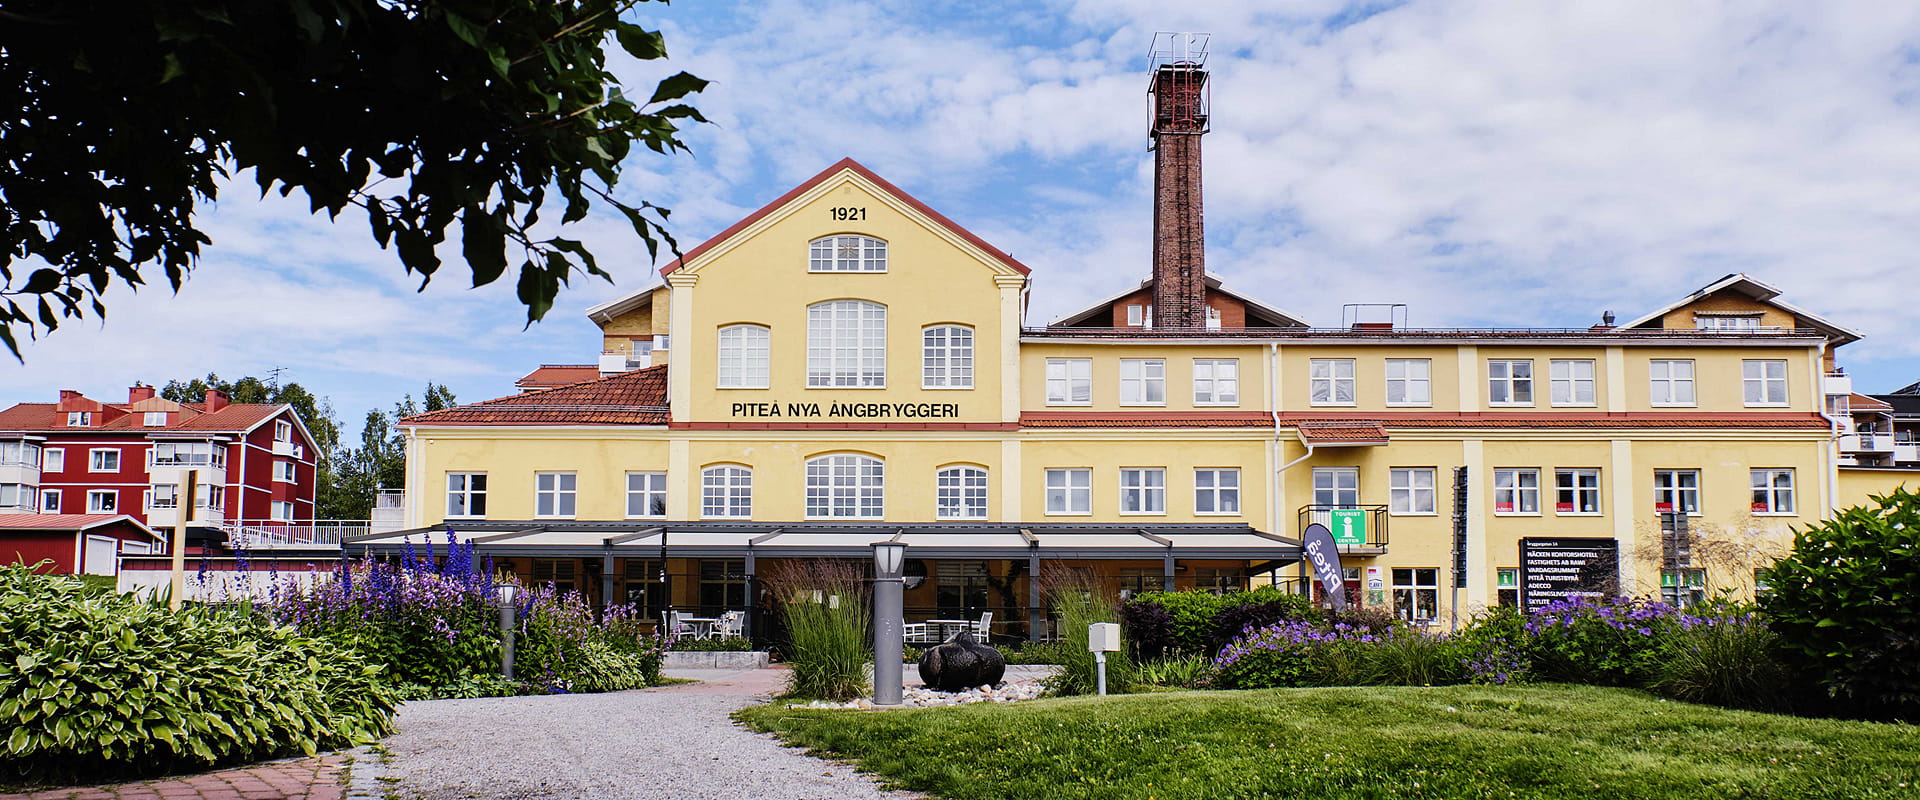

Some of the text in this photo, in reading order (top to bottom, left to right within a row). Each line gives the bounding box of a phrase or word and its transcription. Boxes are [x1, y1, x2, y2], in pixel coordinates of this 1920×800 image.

[830, 207, 866, 221] 1921
[732, 399, 959, 418] PITEÅ NYA ÅNGBRYGGERI
[1527, 550, 1551, 558] NÄCKEN
